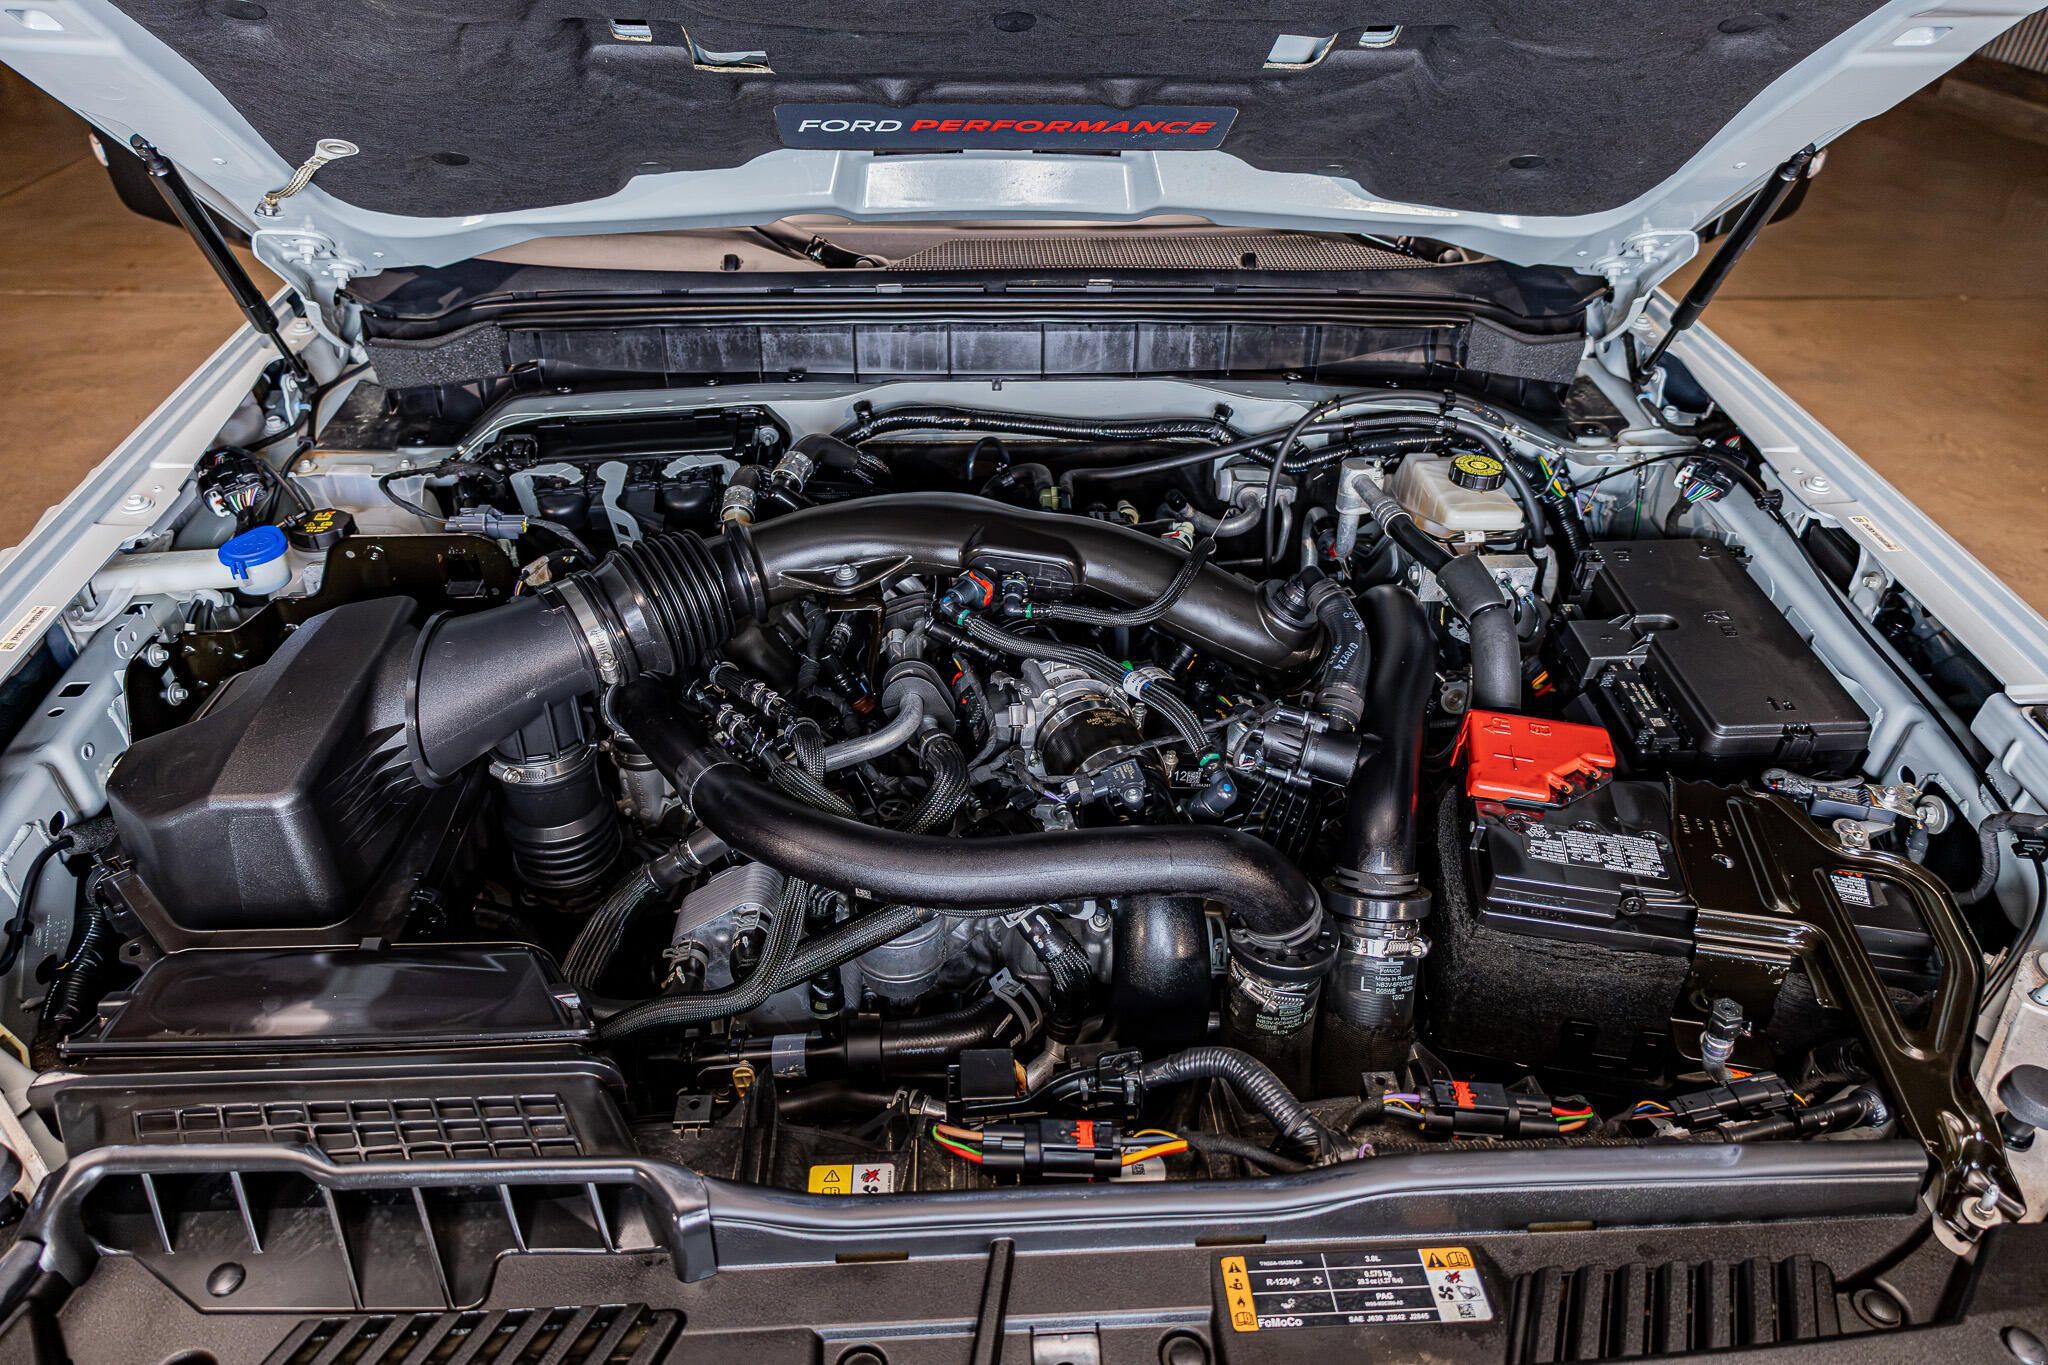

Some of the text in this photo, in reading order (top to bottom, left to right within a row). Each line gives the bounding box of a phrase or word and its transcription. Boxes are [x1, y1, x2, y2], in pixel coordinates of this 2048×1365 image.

[797, 119, 1218, 135] FORD PERFORMANCE
[1381, 852, 1392, 870] L
[1360, 975, 1372, 992] L
[1265, 1277, 1301, 1288] R-1234yf
[1375, 1292, 1394, 1300] PAG
[1257, 1316, 1303, 1328] FoMoCo
[1348, 1315, 1365, 1323] SAE
